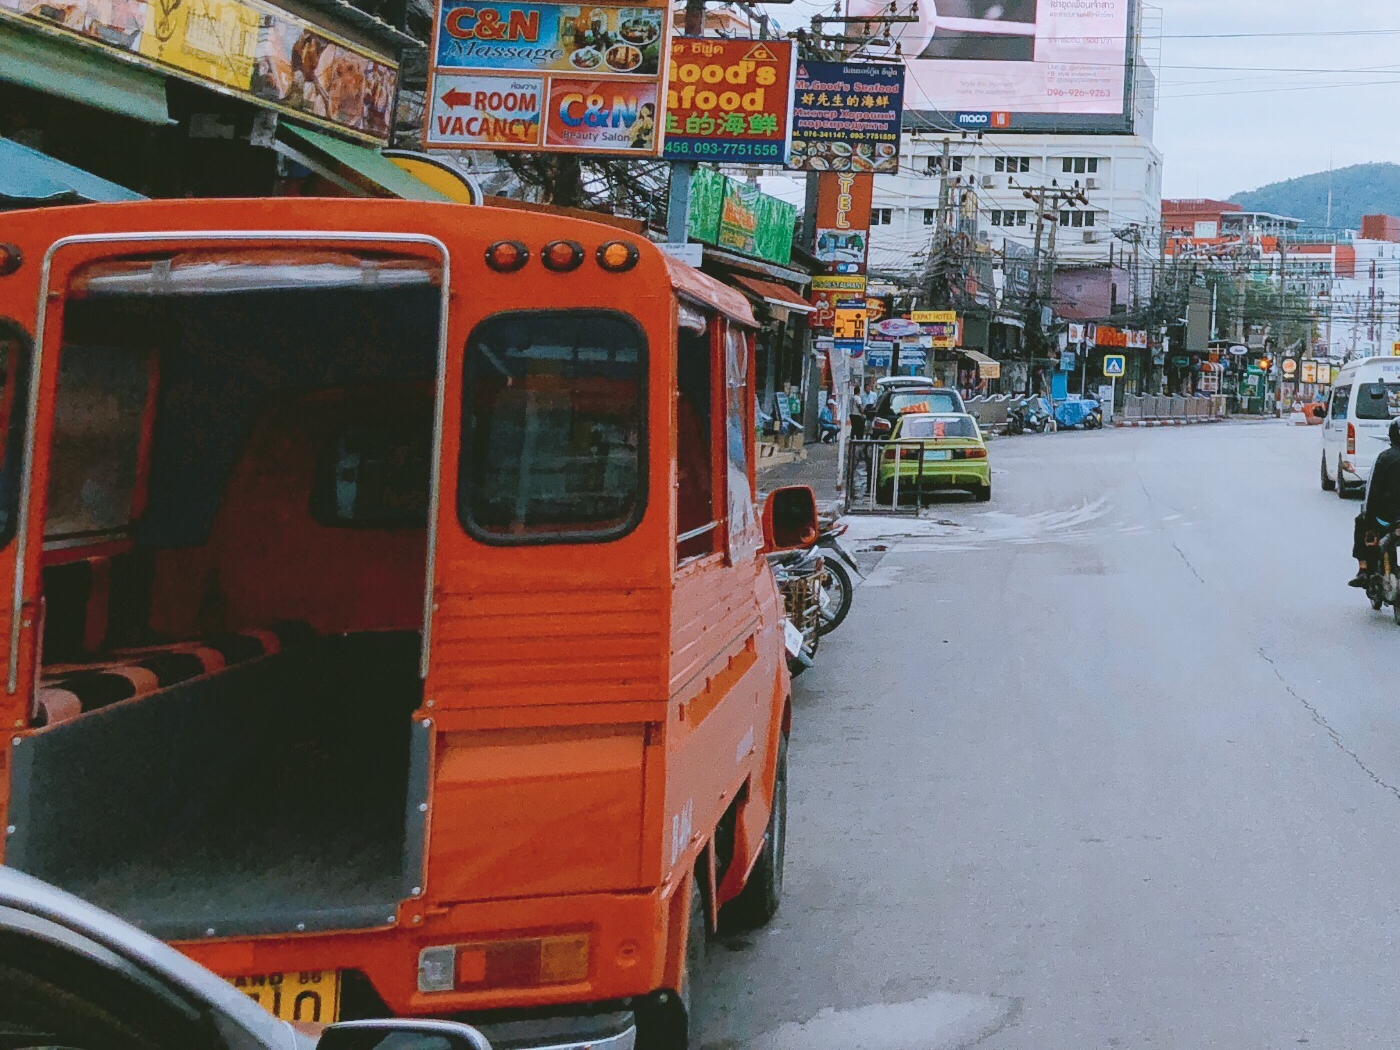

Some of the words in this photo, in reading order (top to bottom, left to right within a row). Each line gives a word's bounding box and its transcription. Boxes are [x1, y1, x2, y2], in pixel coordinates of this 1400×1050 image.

[445, 6, 540, 42] C&N
[441, 39, 564, 64] Massage
[853, 82, 900, 93] Seafood
[474, 91, 537, 112] ROOM
[559, 94, 638, 129] C&N
[437, 115, 534, 138] VACANCY
[562, 130, 599, 143] Beauty
[601, 131, 631, 143] Salon
